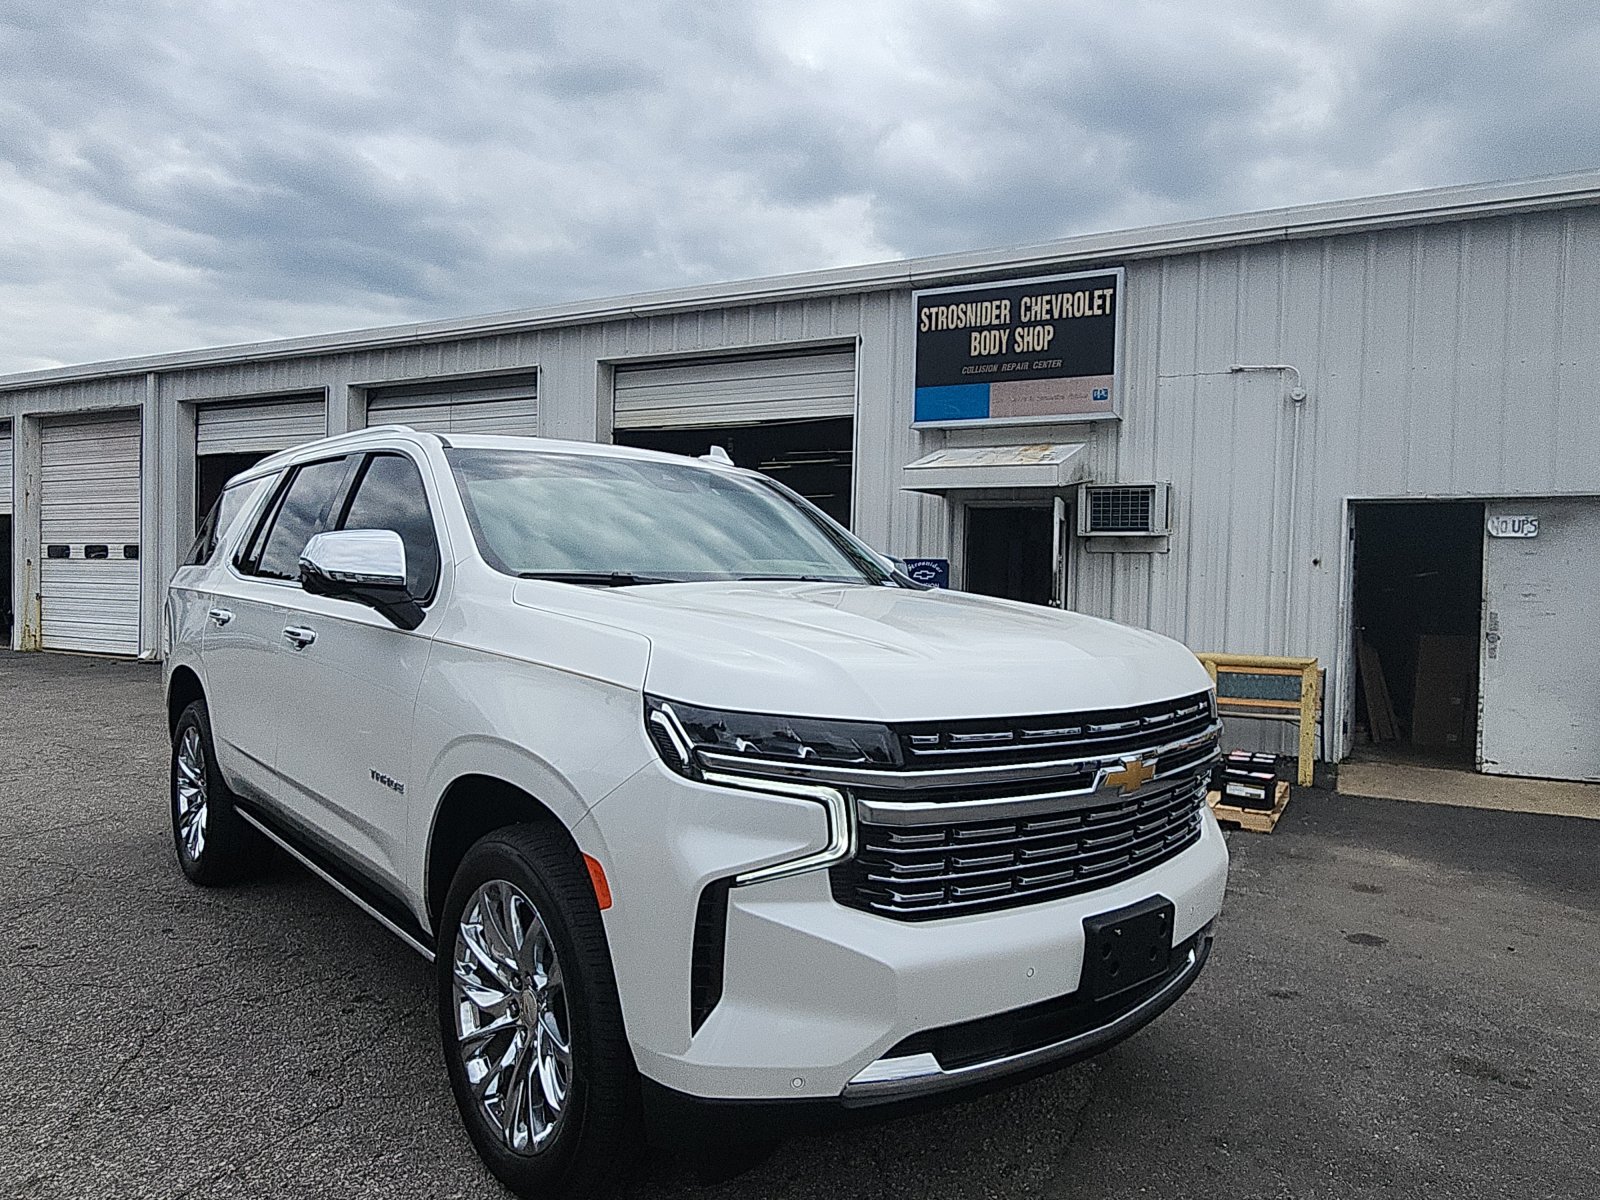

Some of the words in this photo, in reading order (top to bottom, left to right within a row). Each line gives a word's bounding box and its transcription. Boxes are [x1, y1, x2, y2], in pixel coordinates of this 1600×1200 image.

[920, 299, 1011, 333] STROSNIDER
[1020, 288, 1114, 323] CHEVROLET
[970, 329, 1010, 356] BODY
[1014, 325, 1054, 353] SHOP
[961, 364, 998, 374] COLLISION
[1001, 362, 1029, 371] REPAIR
[1032, 359, 1063, 369] CENTER
[1512, 519, 1538, 534] UPS
